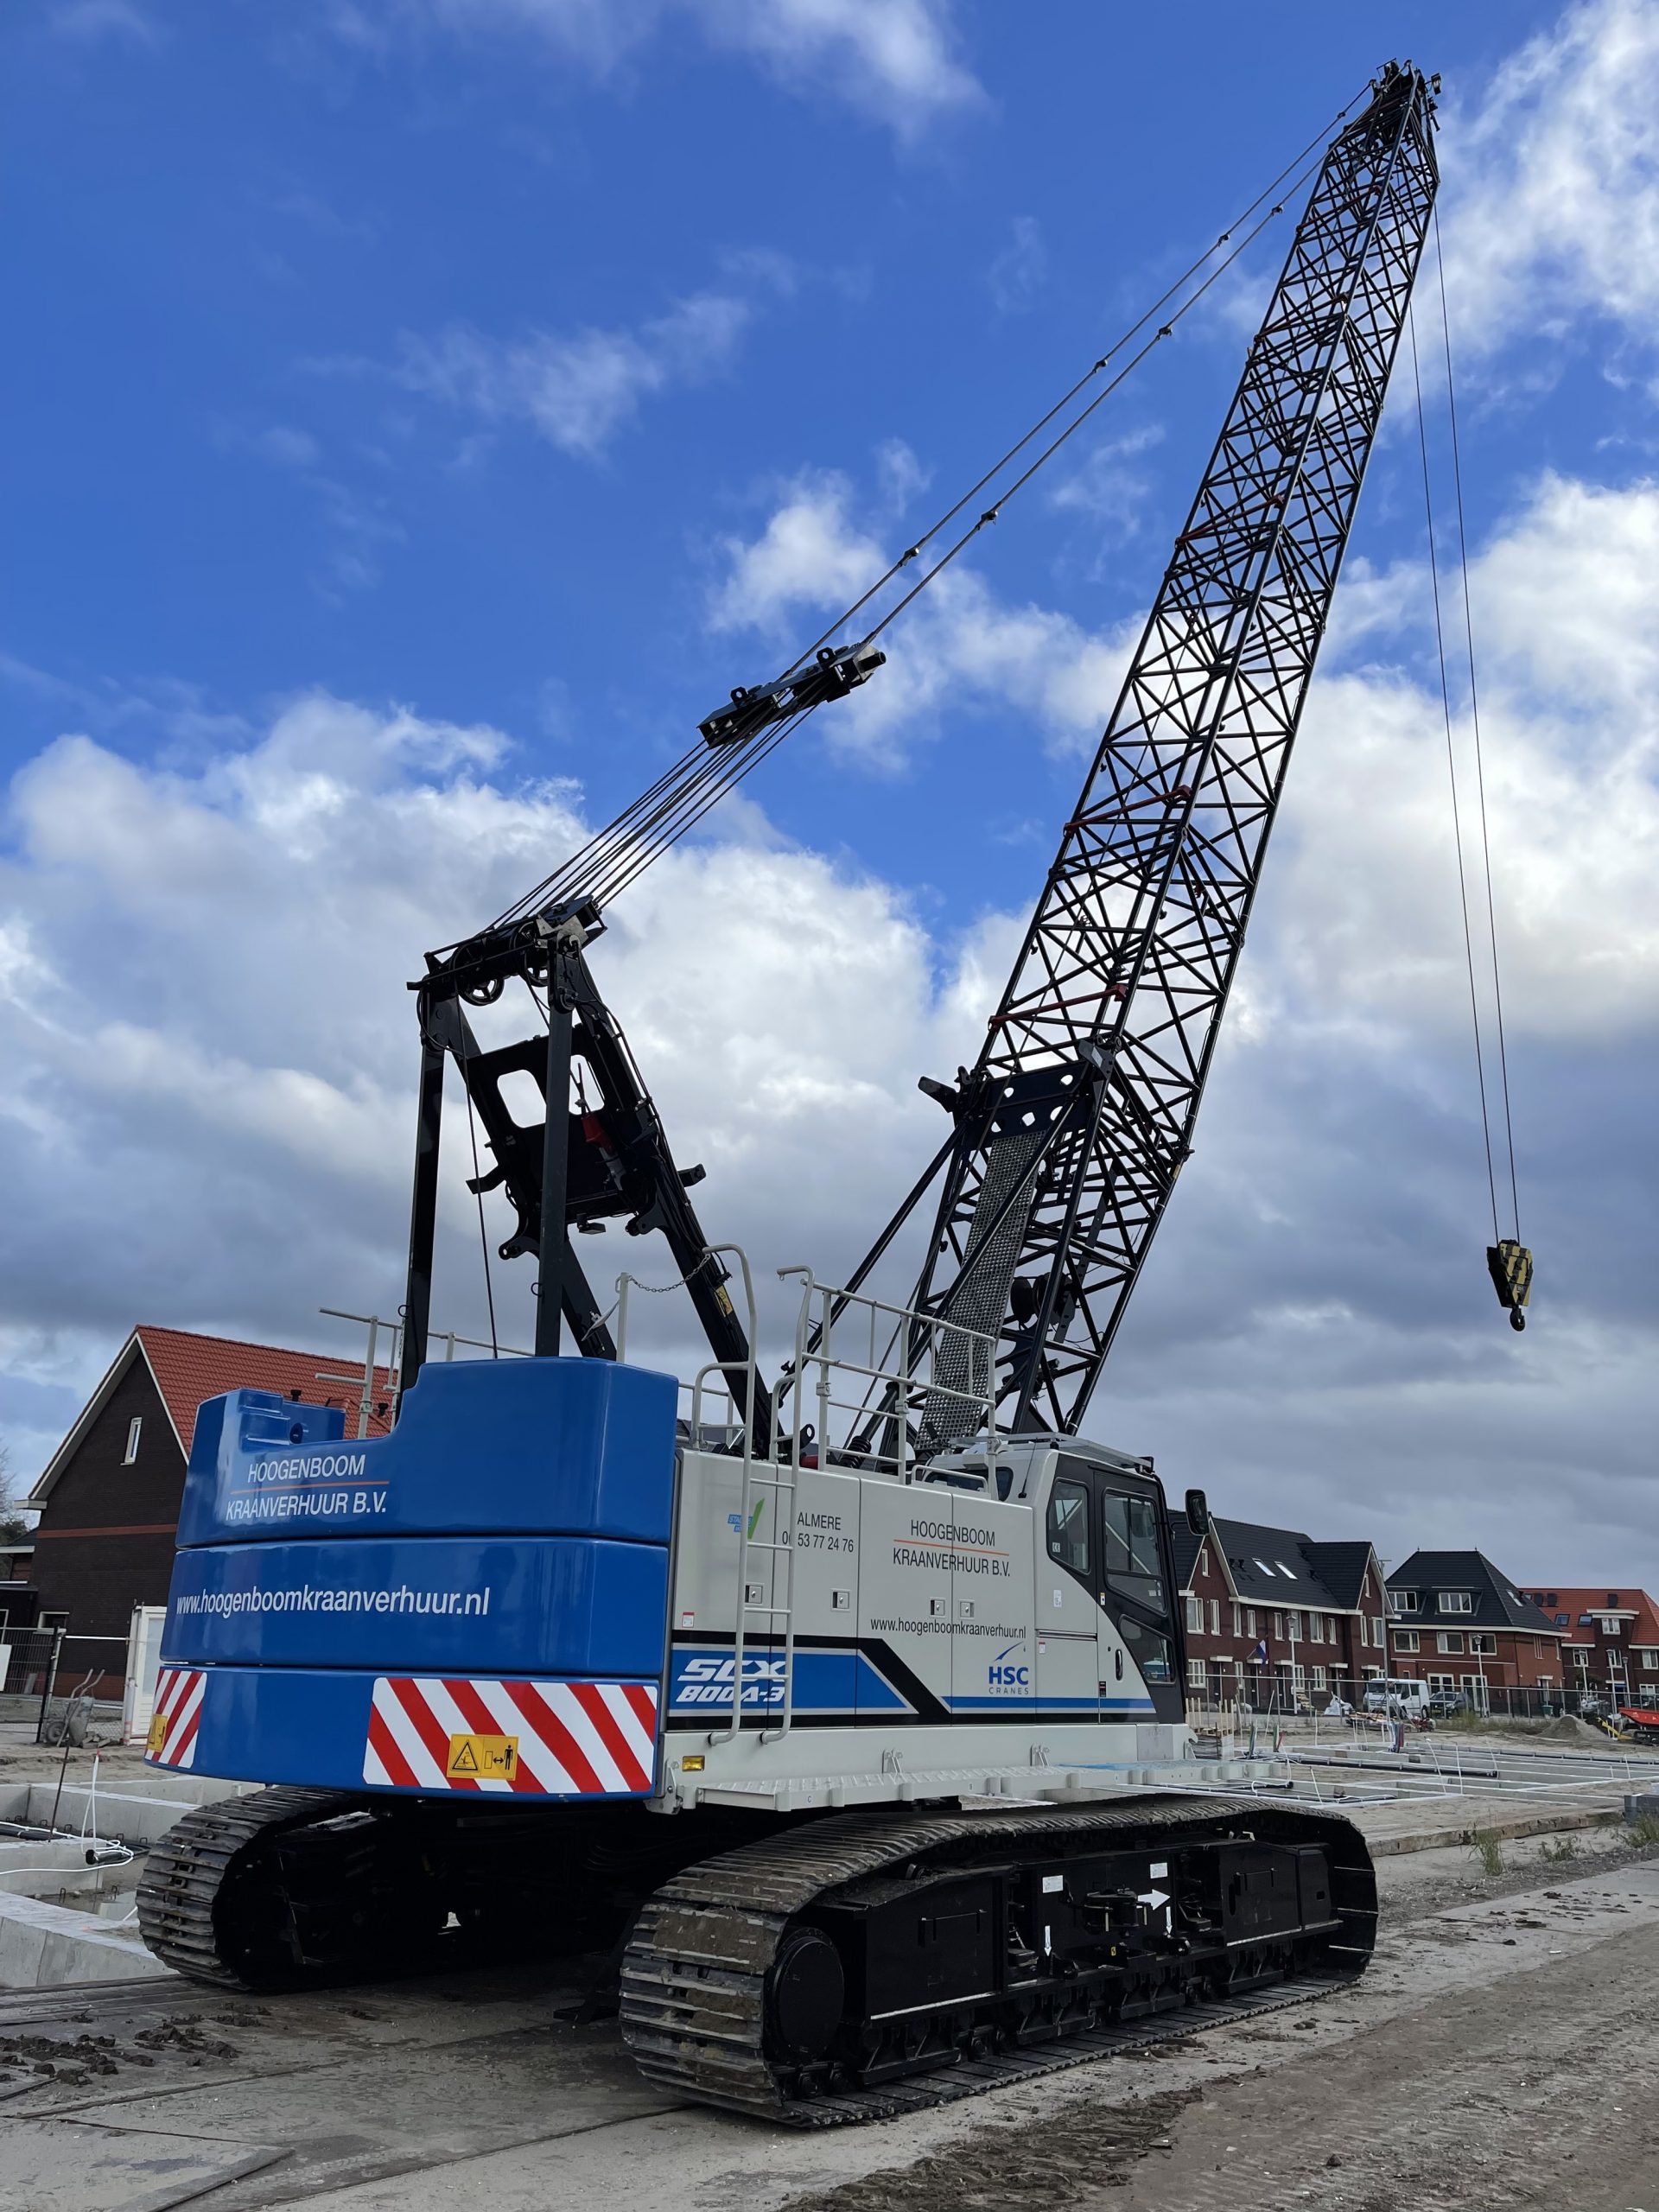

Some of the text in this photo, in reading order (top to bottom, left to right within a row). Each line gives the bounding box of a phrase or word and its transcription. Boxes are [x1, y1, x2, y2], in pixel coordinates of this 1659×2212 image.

[247, 1454, 365, 1484] HOOGENBOOM
[226, 1491, 386, 1521] KRAANVERHUUR B.V.
[797, 1512, 842, 1531] ALMERE
[798, 1533, 810, 1548] 53
[813, 1535, 825, 1549] 77
[828, 1536, 839, 1551] 24
[842, 1538, 854, 1553] 76
[911, 1519, 995, 1547] HOOGENBOOM
[893, 1548, 1010, 1577] KRAANVERHUUR B.V.
[176, 1584, 489, 1618] www.hoogenboomkraanverhuur.nl
[870, 1618, 1027, 1639] www.hoogenboomkraanverhuur.nl
[677, 1658, 786, 1682] SCX
[988, 1666, 1029, 1686] HSC
[676, 1685, 785, 1702] 800A-3
[988, 1687, 1029, 1695] CRANES
